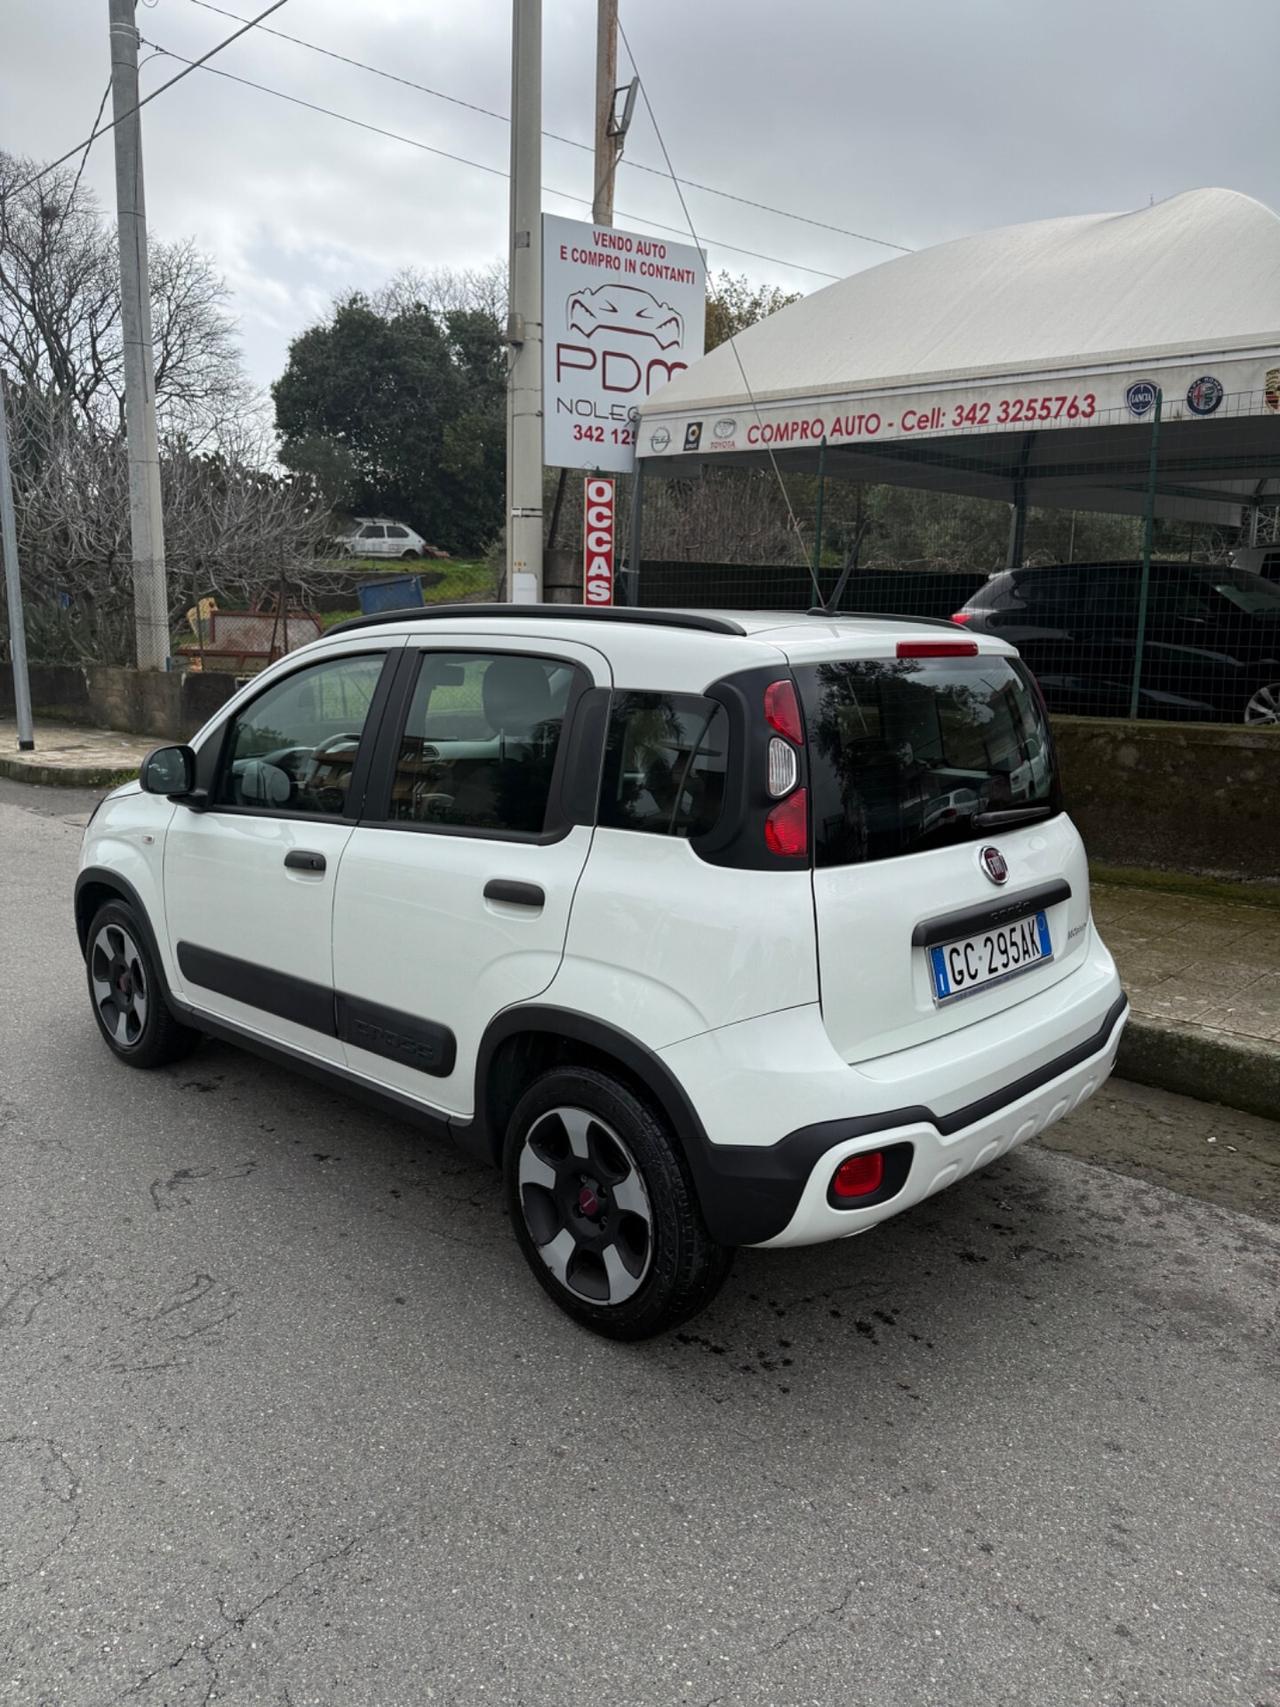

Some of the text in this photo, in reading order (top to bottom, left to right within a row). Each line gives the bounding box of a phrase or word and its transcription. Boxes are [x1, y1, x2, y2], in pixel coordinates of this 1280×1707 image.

[593, 231, 667, 260] VENDO AUTO
[560, 245, 696, 285] E COMPRO IN CONTANTI
[1131, 391, 1152, 403] LANCIA
[573, 424, 605, 442] 342
[747, 418, 825, 445] COMPRO
[830, 413, 881, 438] AUTO
[901, 407, 946, 432] Cell:
[952, 402, 991, 427] 342
[997, 393, 1097, 424] 3255763
[710, 440, 736, 449] TOYOTA
[587, 481, 613, 602] OCCAS
[949, 942, 979, 986] GC
[984, 918, 1040, 975] 295AK
